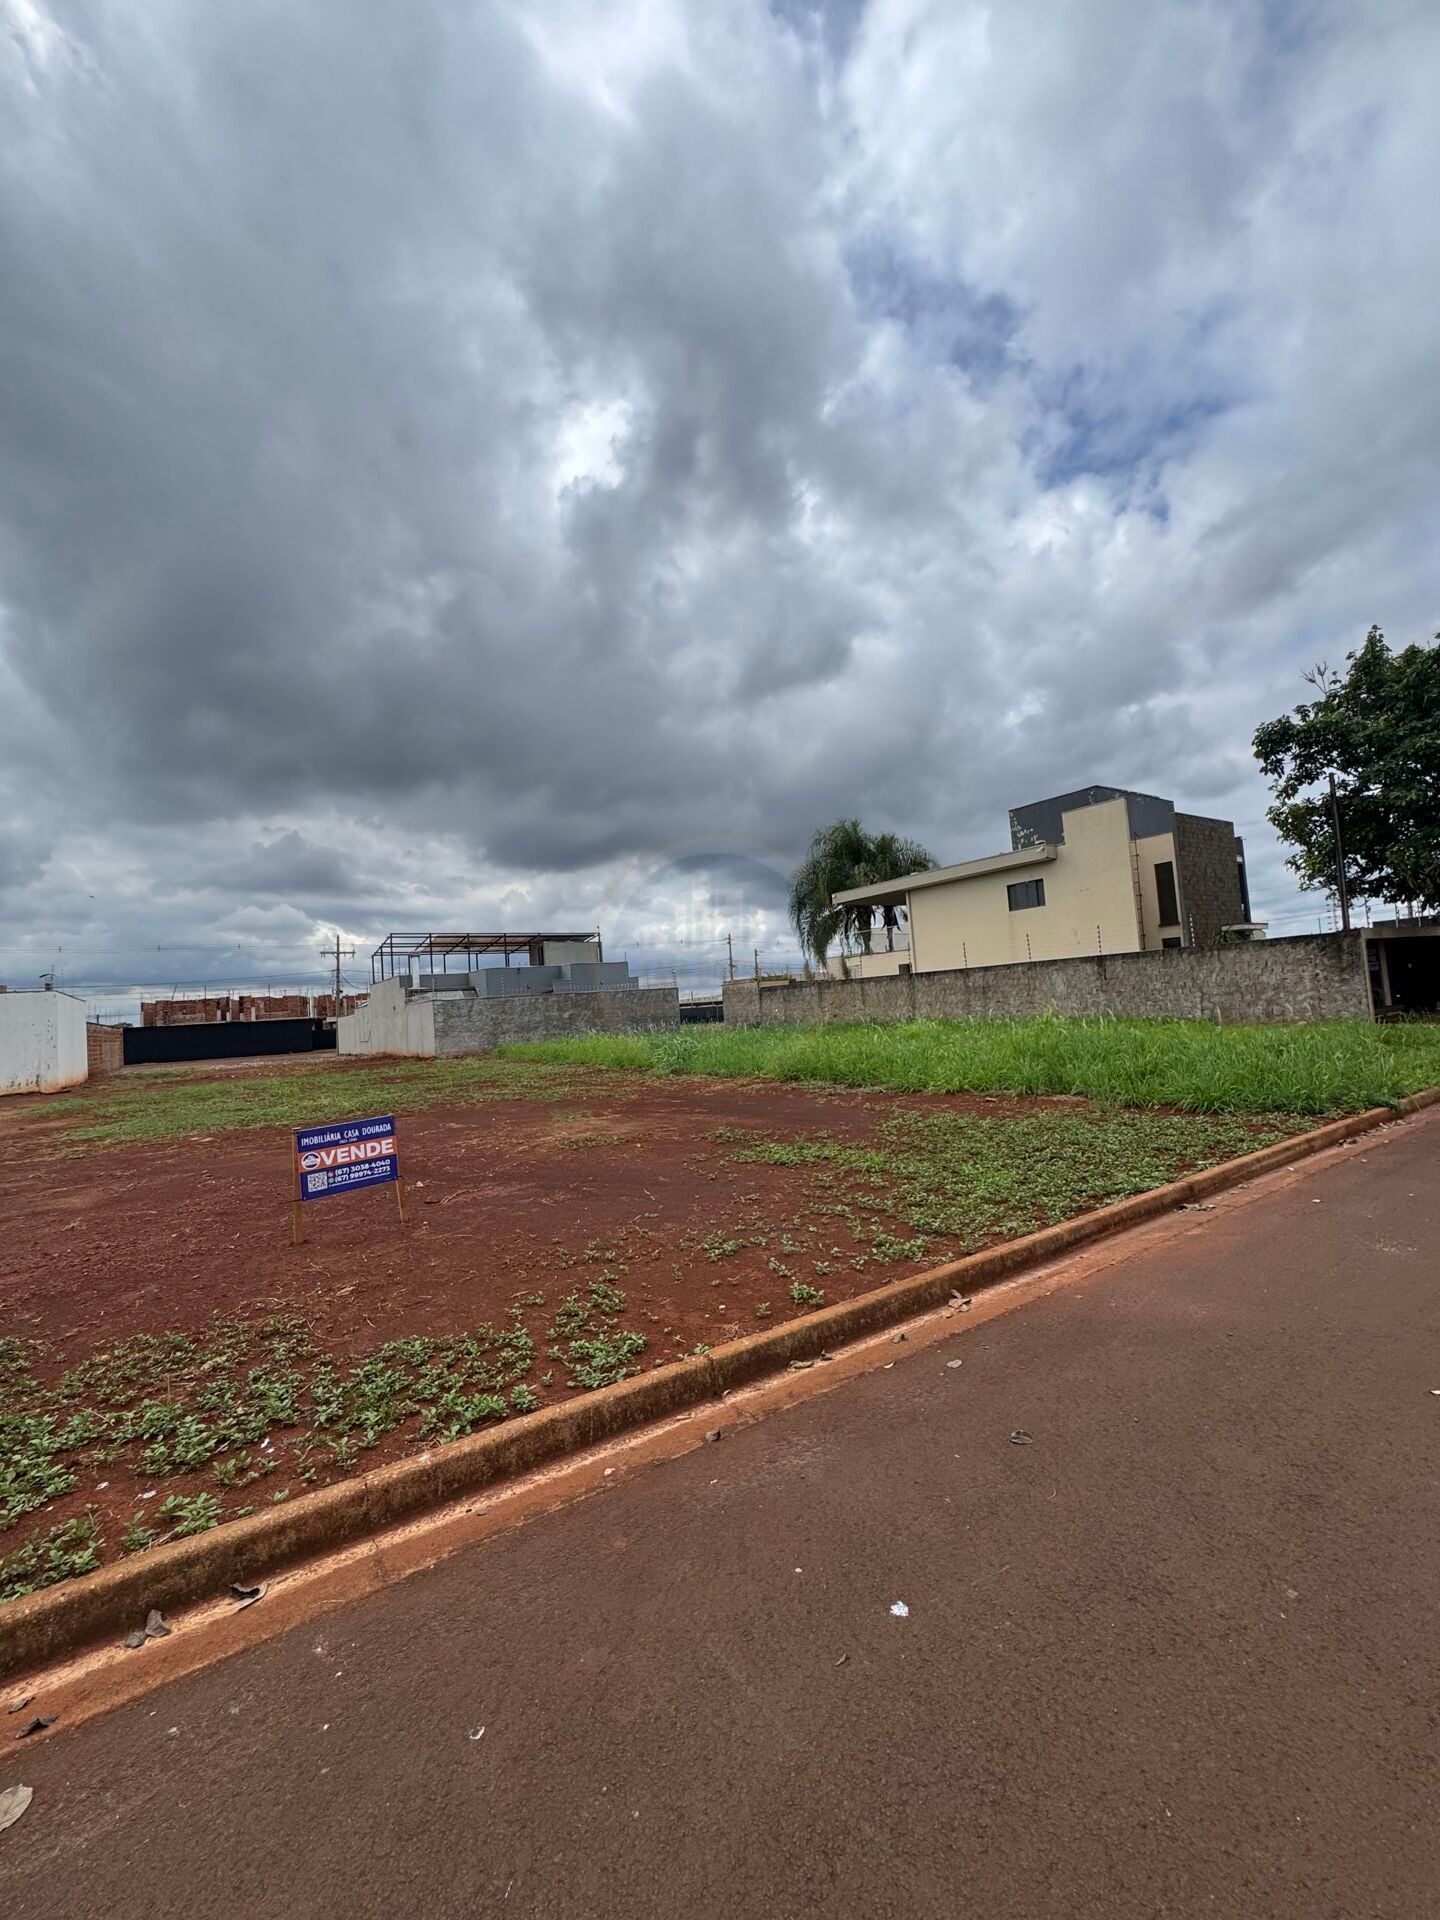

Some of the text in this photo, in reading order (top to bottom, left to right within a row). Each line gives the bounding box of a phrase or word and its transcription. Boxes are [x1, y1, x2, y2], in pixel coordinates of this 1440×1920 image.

[301, 1132, 341, 1147] IMOBILIÁRIA
[344, 1129, 359, 1138] CASA
[362, 1123, 391, 1135] DOURADA
[320, 1139, 394, 1165] VENDE
[335, 1167, 349, 1176] (67)
[335, 1175, 348, 1183] (67)
